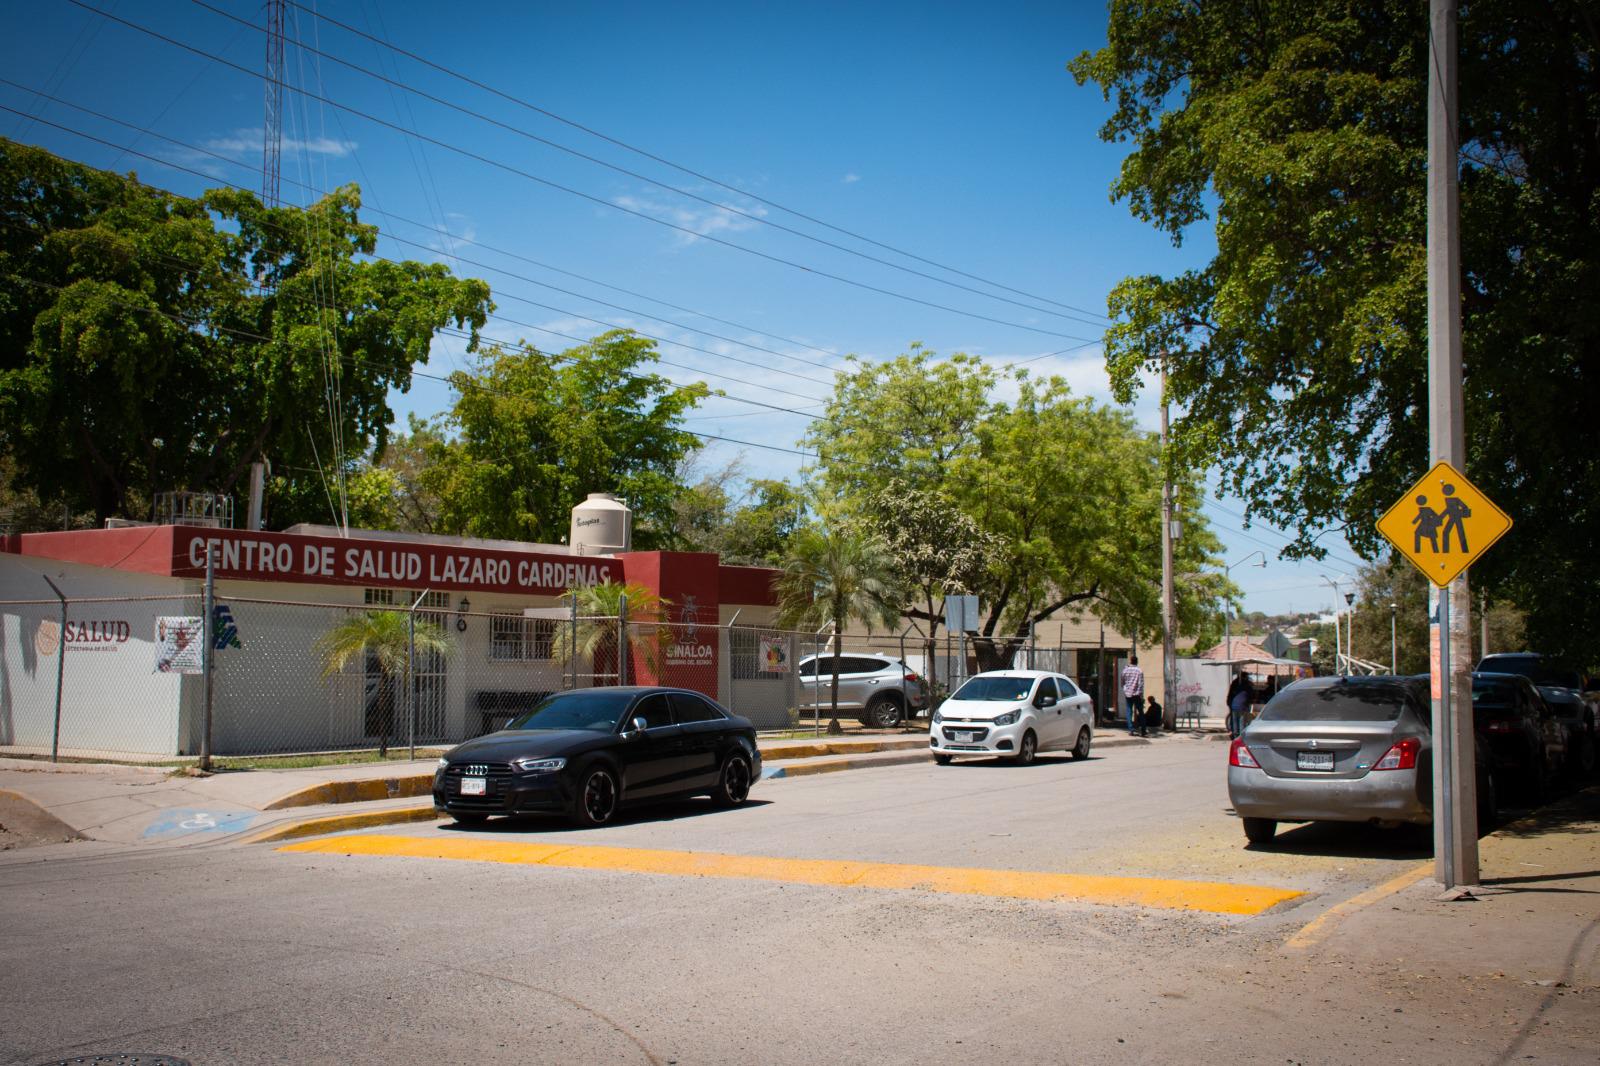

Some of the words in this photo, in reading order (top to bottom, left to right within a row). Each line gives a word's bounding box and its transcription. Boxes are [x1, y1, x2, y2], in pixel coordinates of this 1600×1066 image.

[189, 536, 293, 573] CENTRO
[303, 544, 335, 576] DE
[344, 548, 422, 581] SALUD
[429, 553, 511, 585] LAZARO
[517, 560, 610, 588] CARDENAS
[64, 620, 131, 643] SALUD
[666, 644, 713, 658] SINALOA
